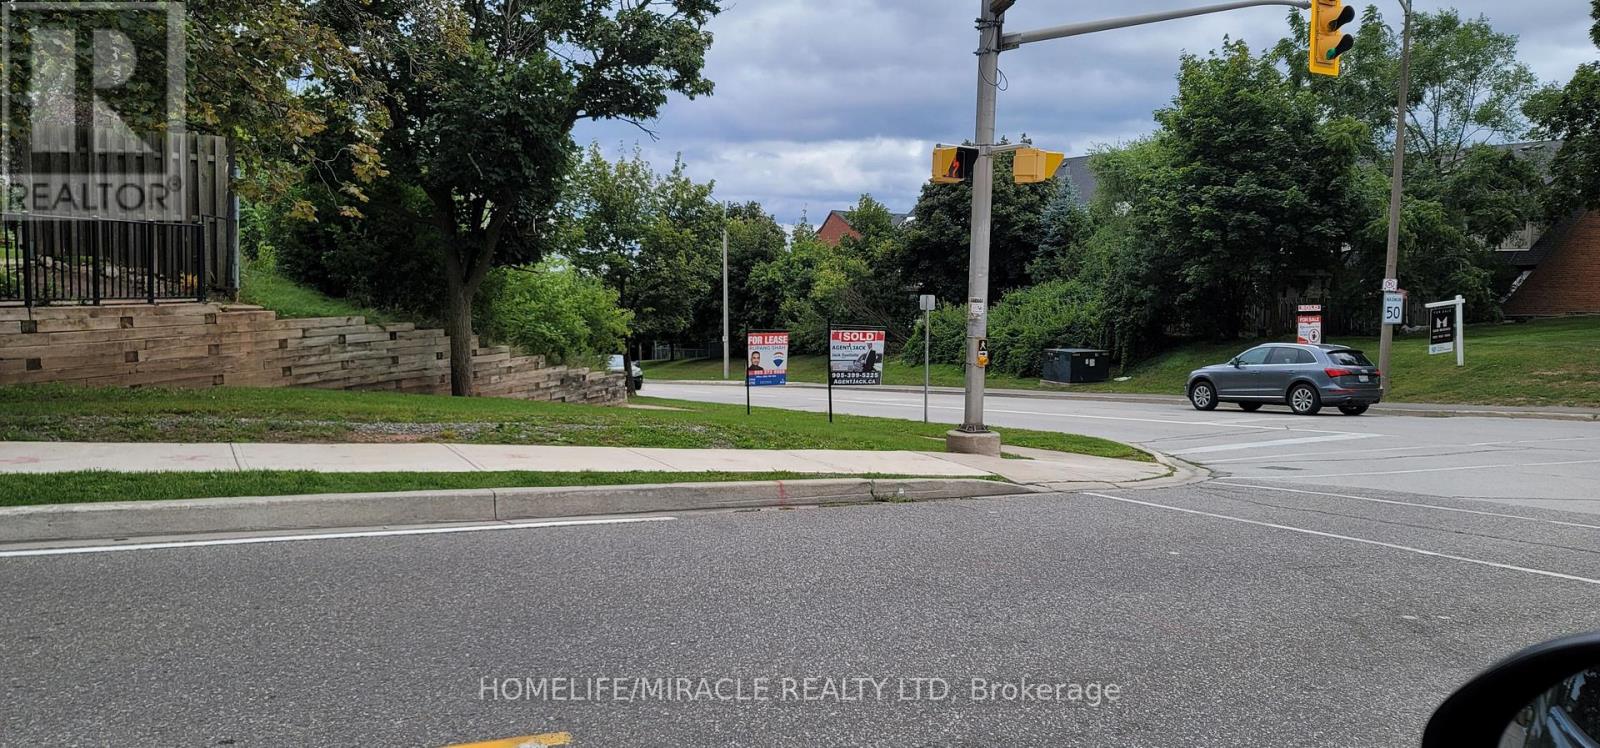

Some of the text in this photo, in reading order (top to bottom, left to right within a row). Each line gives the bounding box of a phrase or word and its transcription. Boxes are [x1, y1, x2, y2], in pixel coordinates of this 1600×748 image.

[1386, 306, 1400, 319] 50
[748, 335, 788, 344] FOR LEASE
[842, 332, 874, 341] SOLD
